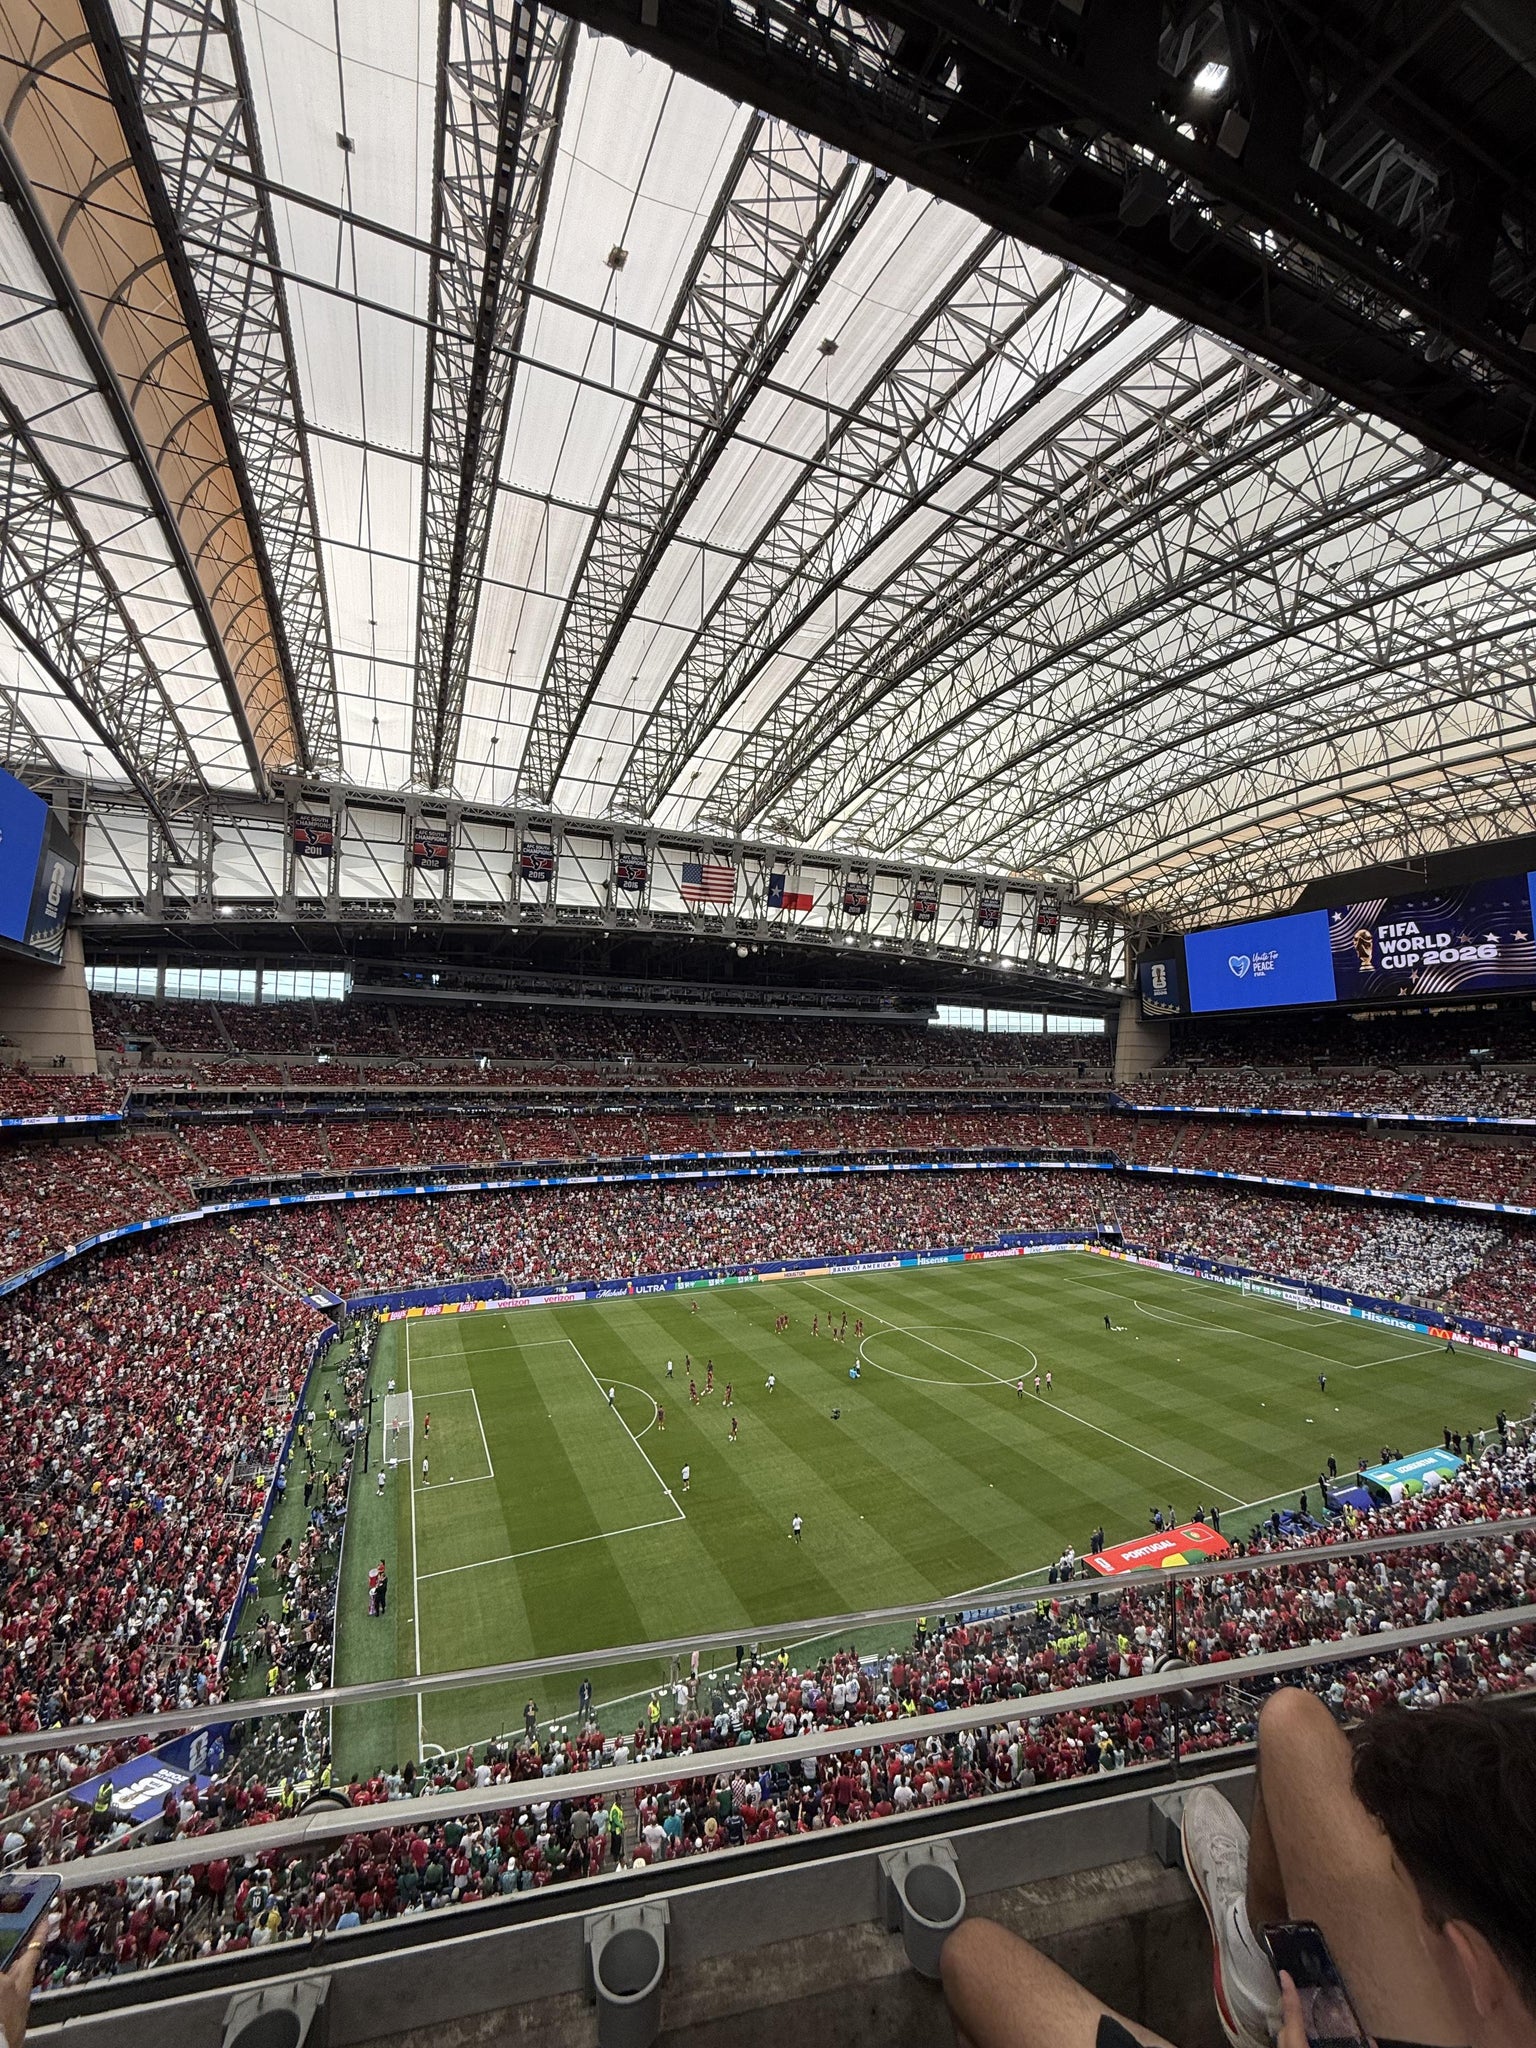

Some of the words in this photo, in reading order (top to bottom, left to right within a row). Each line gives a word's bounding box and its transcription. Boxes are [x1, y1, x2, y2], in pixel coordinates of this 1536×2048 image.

[296, 820, 331, 828] CHAMPIONS
[415, 834, 447, 842] CHAMPIONS
[304, 846, 322, 855] 2011
[421, 859, 440, 867] 2012
[528, 871, 545, 879] 2015
[1378, 922, 1420, 939] FIFA
[1379, 933, 1451, 954] WORLD
[1253, 952, 1269, 962] Unite
[1269, 950, 1278, 959] For
[1381, 953, 1419, 969] CUP
[1423, 944, 1498, 965] 2026
[1253, 961, 1274, 971] PEACE
[983, 1248, 1019, 1258] McDonald's
[918, 1257, 948, 1266] Hisense
[1201, 1273, 1224, 1283] ULTRA
[636, 1285, 666, 1294] ULTRA
[498, 1298, 530, 1308] verizon
[544, 1294, 575, 1303] verizon
[1362, 1310, 1416, 1331] Hisense
[1485, 1325, 1502, 1333] FIFA
[1120, 1540, 1176, 1561] PORTUGAL
[252, 1896, 261, 1908] 10
